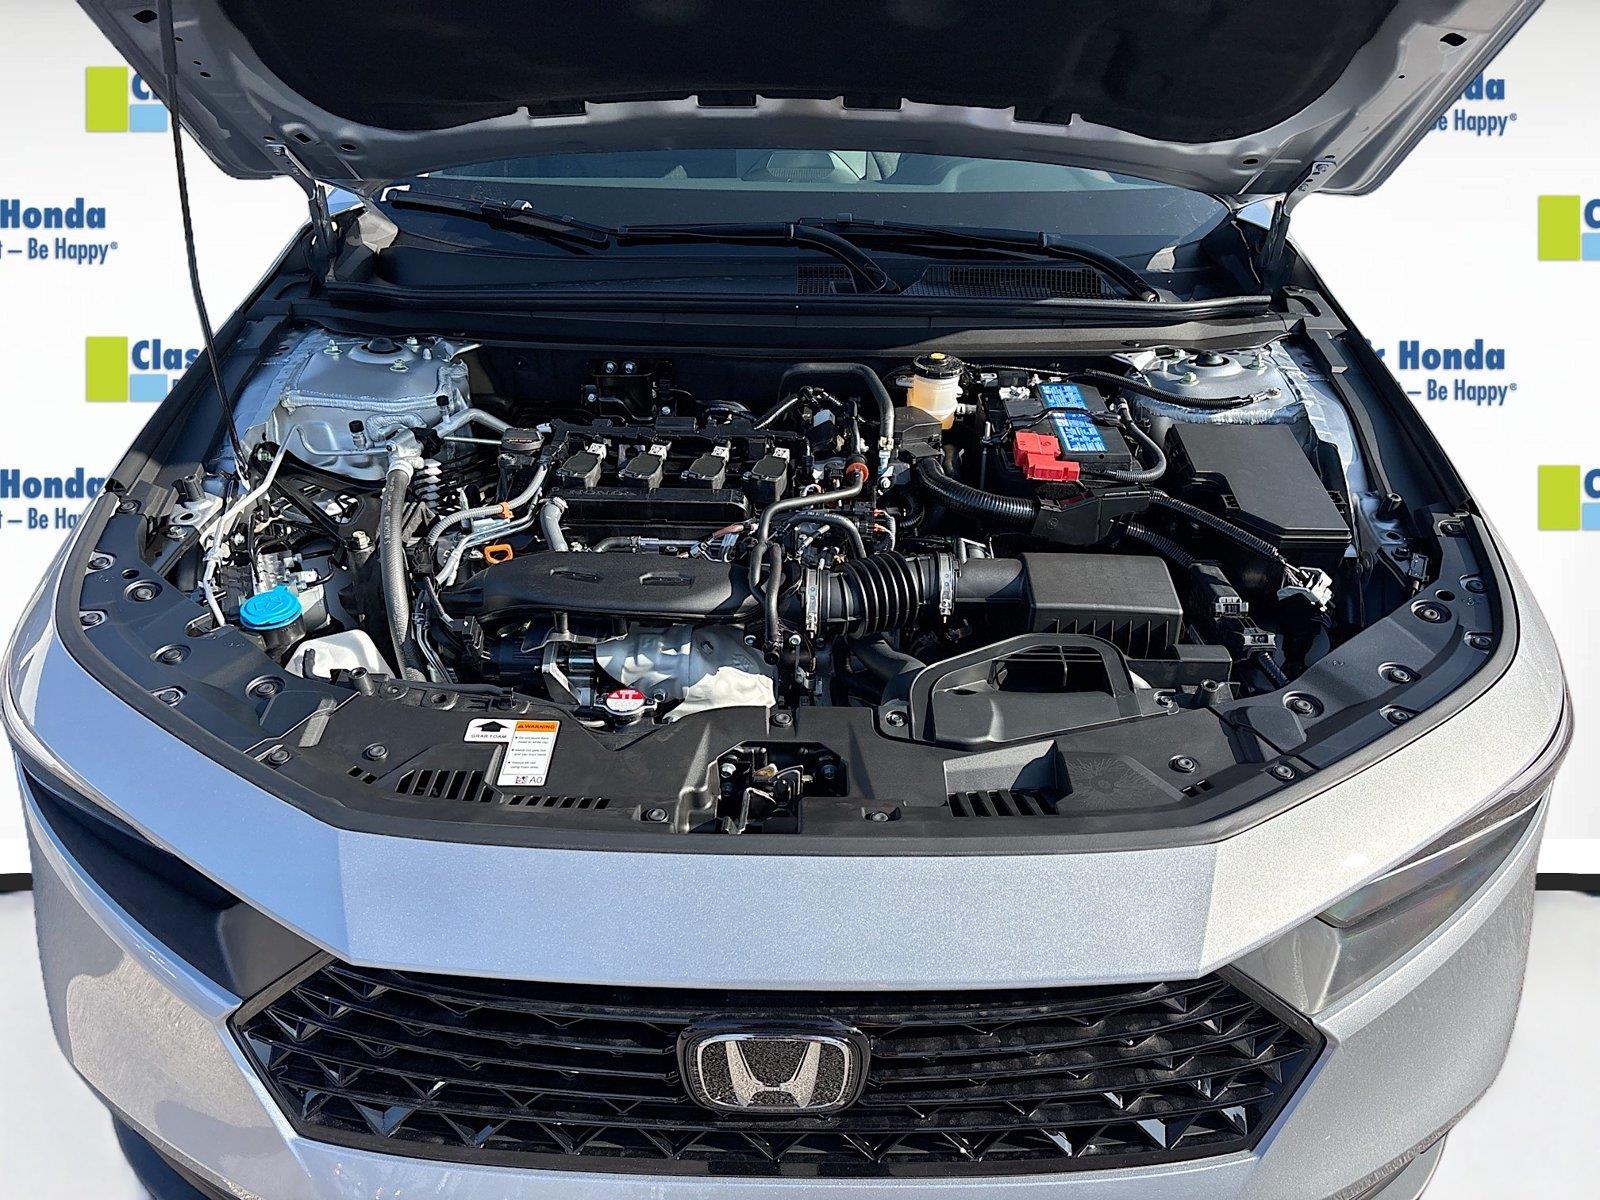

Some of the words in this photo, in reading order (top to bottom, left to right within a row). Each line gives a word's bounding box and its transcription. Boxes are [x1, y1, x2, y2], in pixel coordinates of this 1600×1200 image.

[0, 198, 106, 228] Honda
[28, 237, 49, 260] Be
[1399, 339, 1505, 370] Honda
[1427, 379, 1448, 401] Be
[28, 507, 49, 529] Be
